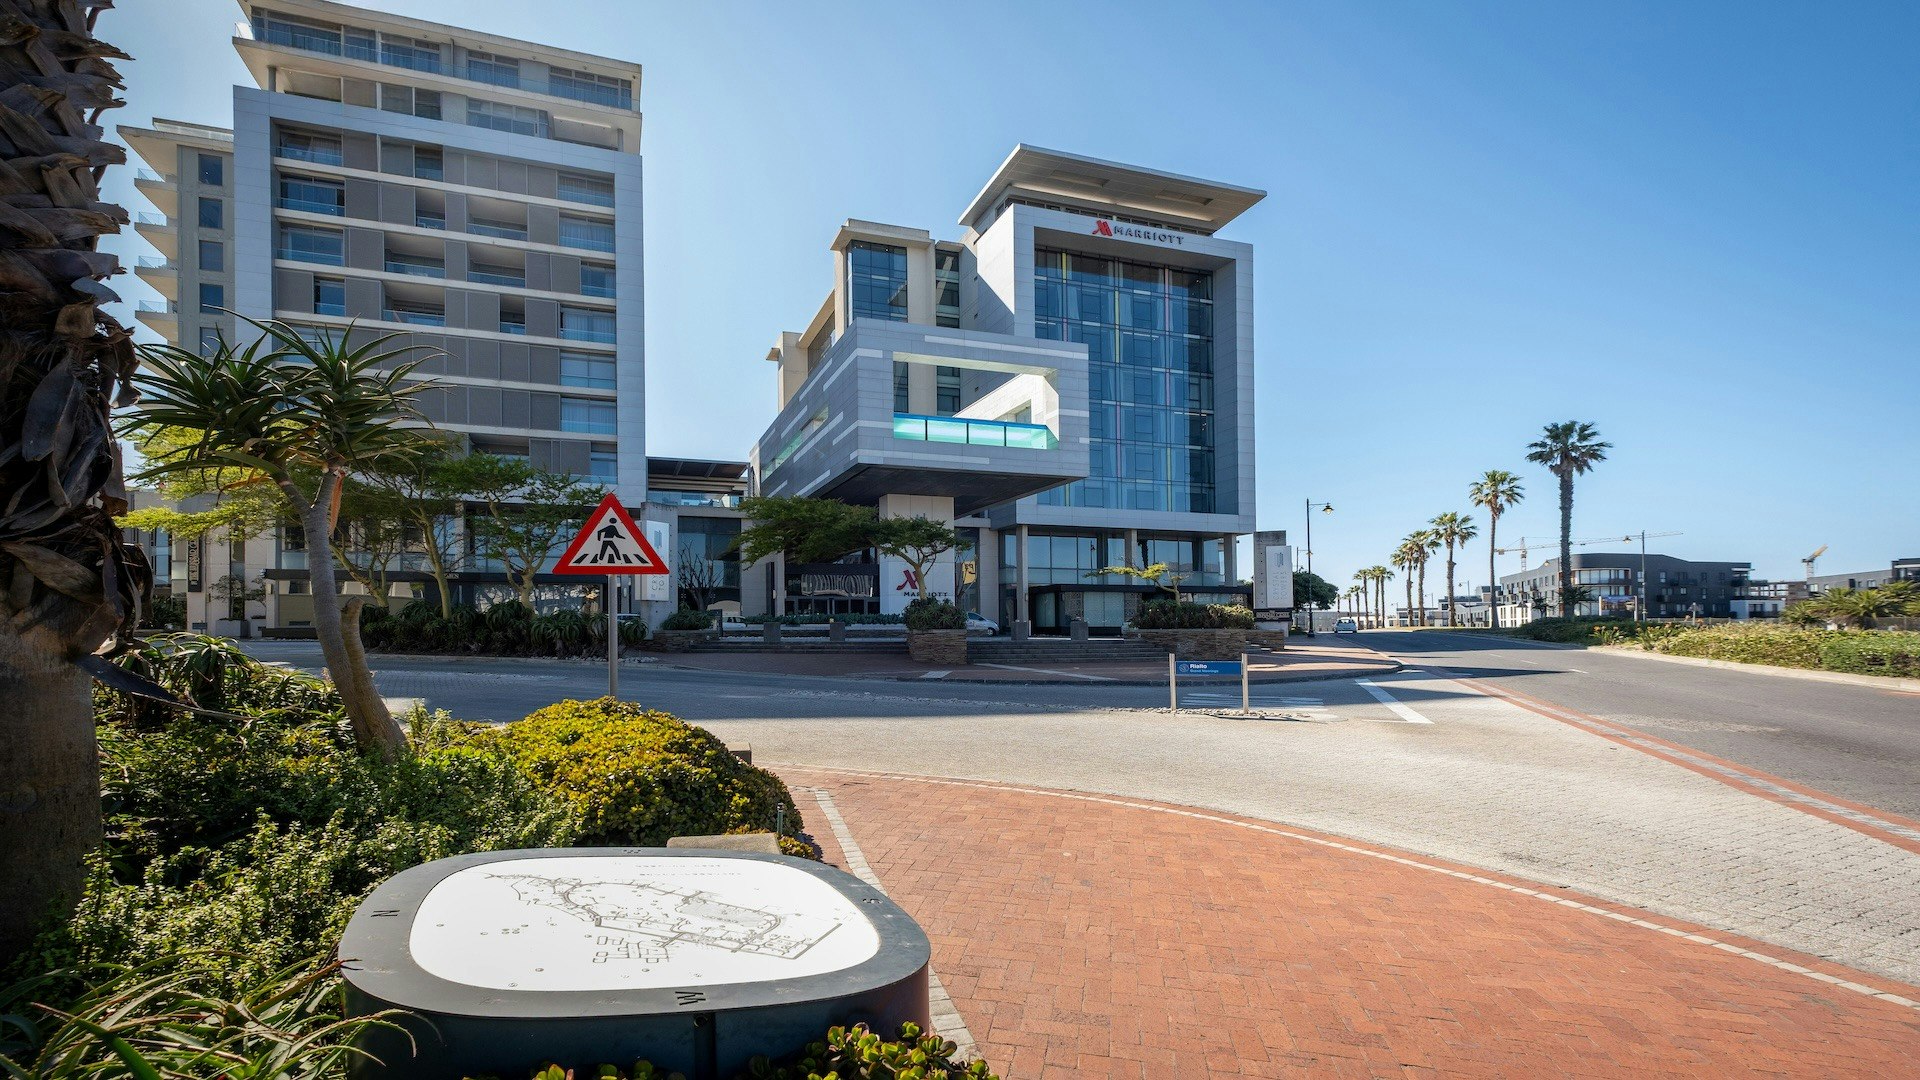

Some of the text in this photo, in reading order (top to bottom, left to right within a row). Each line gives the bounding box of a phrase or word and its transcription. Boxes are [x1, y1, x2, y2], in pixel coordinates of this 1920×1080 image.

[1114, 225, 1184, 244] MARRIOTT
[1272, 572, 1280, 600] CRYSTAL
[1280, 572, 1288, 600] TOWERS
[370, 909, 401, 918] N
[675, 991, 706, 1006] W
